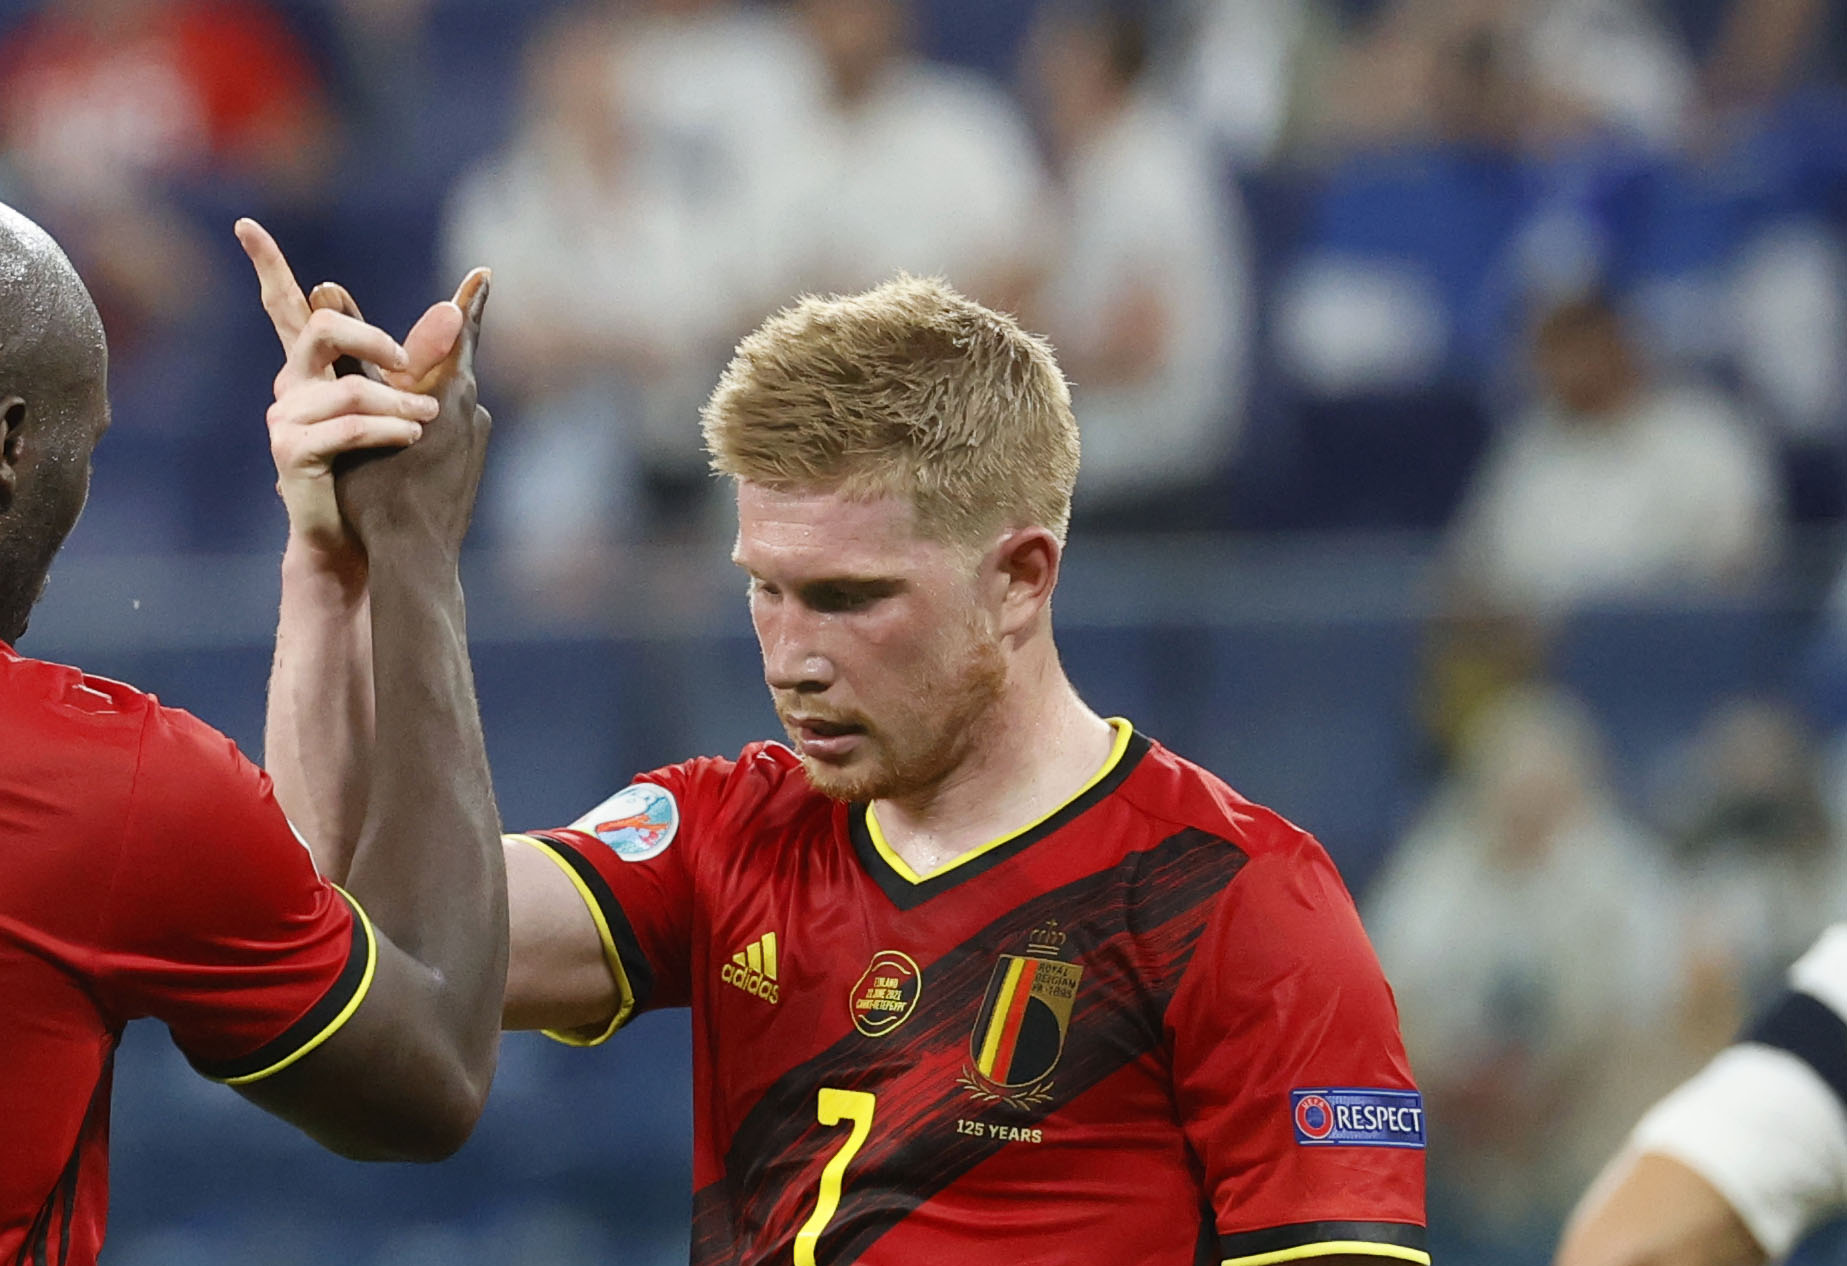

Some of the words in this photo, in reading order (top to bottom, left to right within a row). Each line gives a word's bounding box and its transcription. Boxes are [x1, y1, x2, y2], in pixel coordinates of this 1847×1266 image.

[721, 963, 779, 1004] adidas
[1301, 1098, 1324, 1108] UEFA
[956, 1118, 985, 1136] 125
[988, 1124, 1042, 1143] YEARS
[1336, 1105, 1422, 1132] RESPECT
